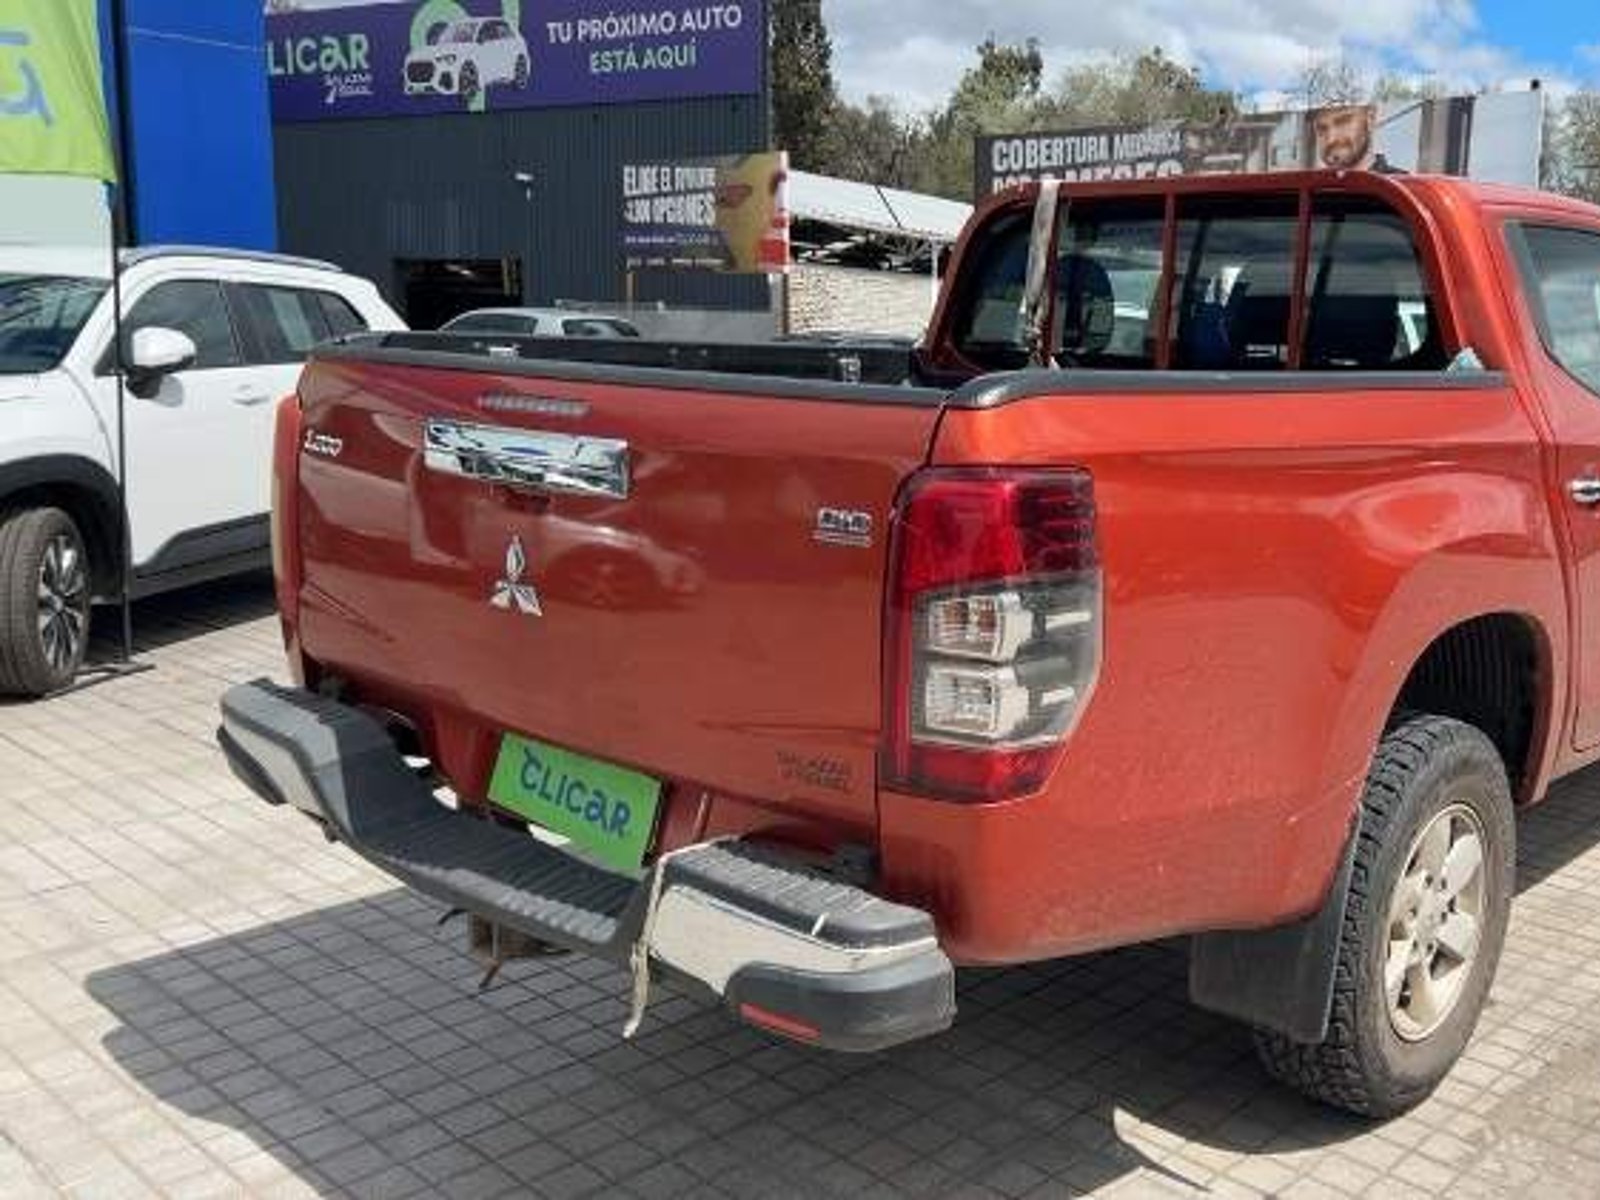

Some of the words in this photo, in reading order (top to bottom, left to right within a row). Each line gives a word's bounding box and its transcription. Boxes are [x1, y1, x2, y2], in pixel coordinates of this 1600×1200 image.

[547, 21, 572, 44] TU
[577, 11, 676, 42] PRÓXIMO
[681, 5, 742, 32] AUTO
[590, 42, 639, 73] ESTÁ
[642, 37, 697, 70] AQUÍ
[991, 135, 1109, 173] COBERTURA
